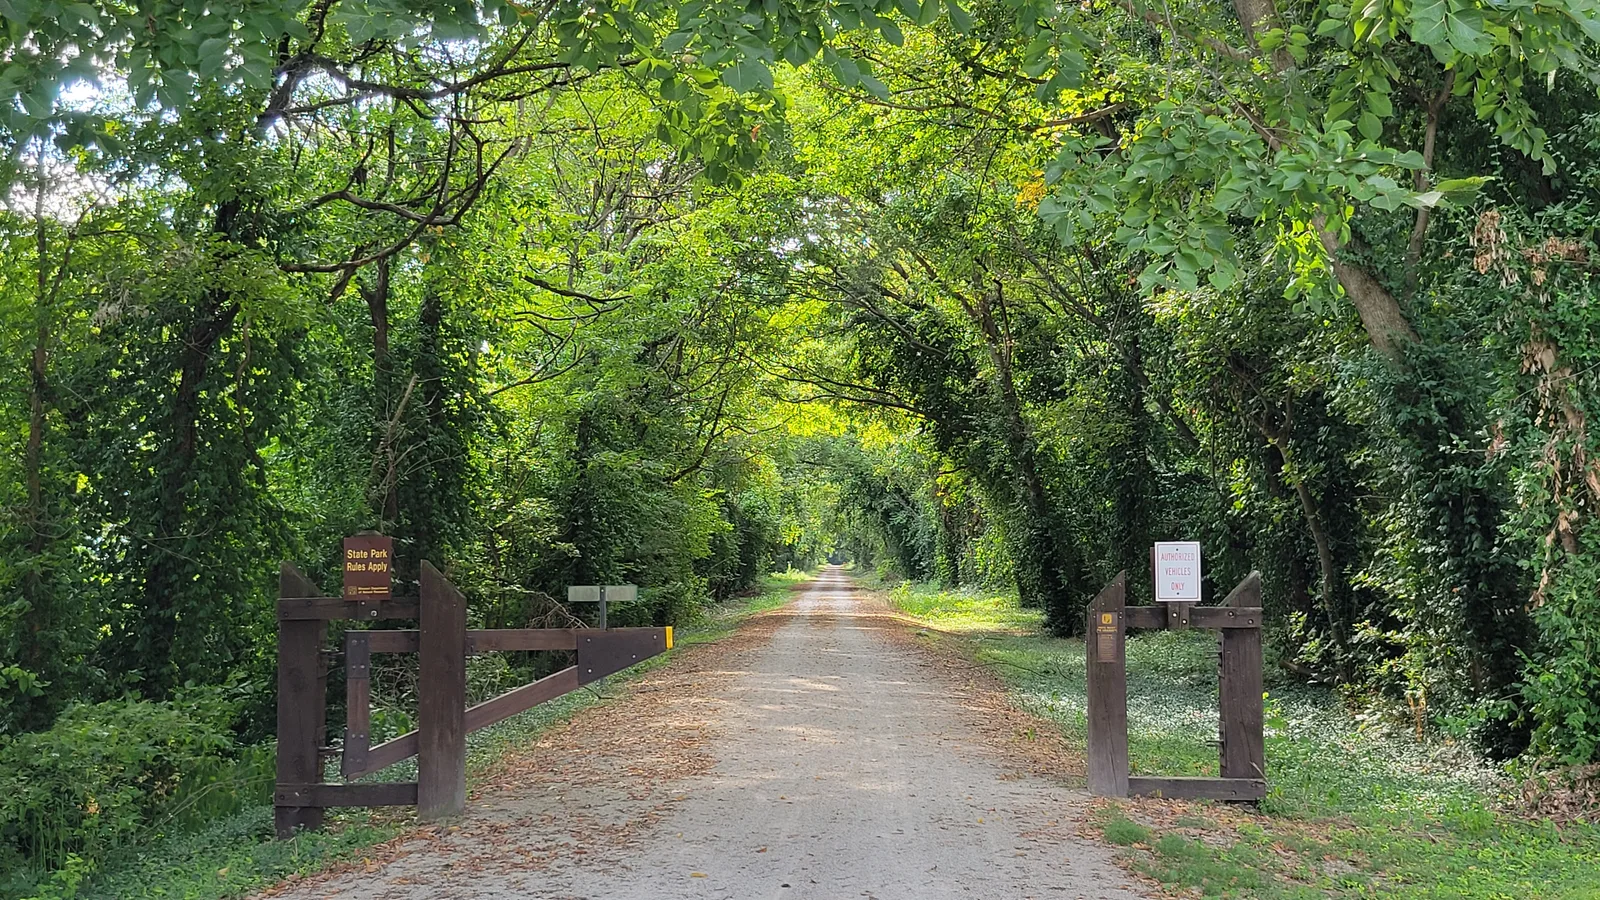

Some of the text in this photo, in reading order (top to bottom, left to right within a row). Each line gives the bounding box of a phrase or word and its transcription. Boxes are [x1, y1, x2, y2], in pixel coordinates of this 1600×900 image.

[347, 549, 388, 559] State Park
[1160, 552, 1195, 561] AUTHORIZED
[346, 561, 388, 573] Rules Apply
[1164, 567, 1191, 576] VEHICLES
[1170, 581, 1185, 591] ONLY
